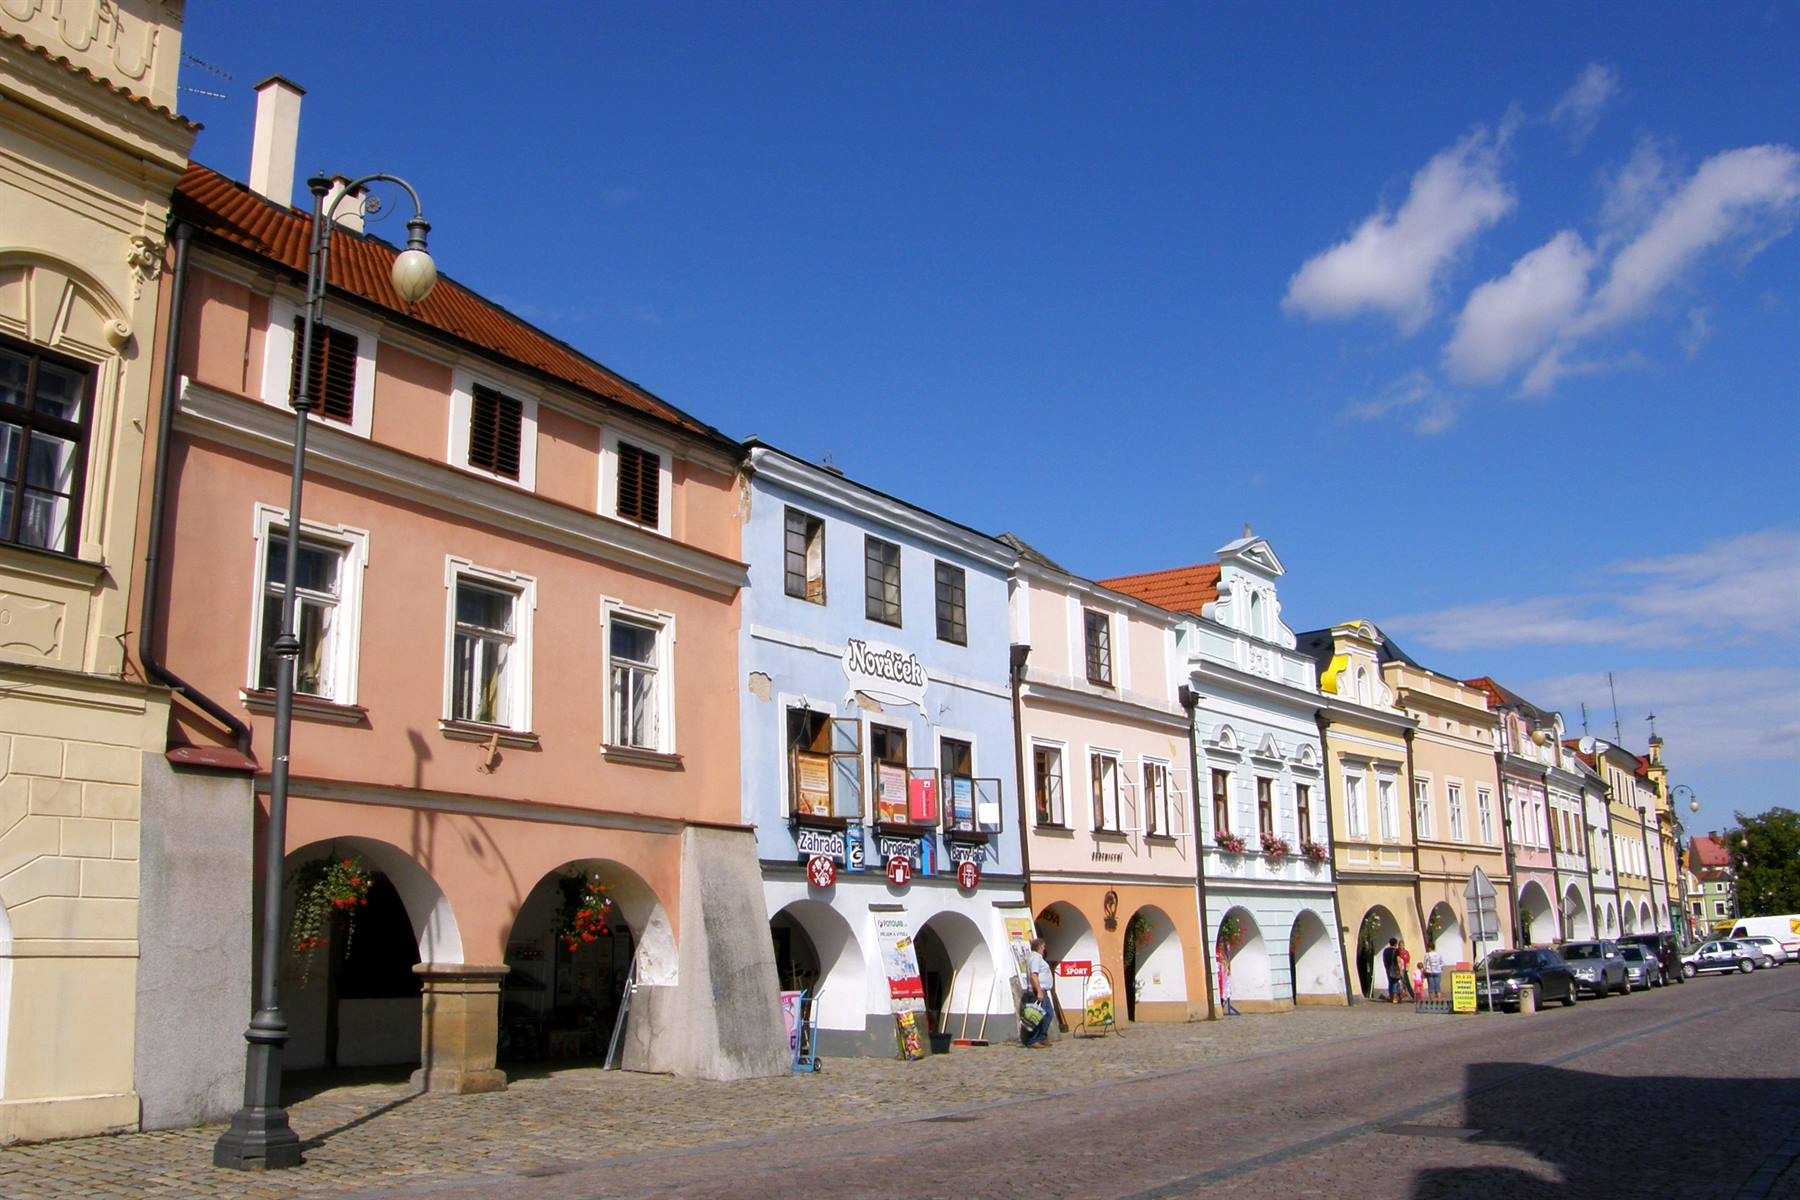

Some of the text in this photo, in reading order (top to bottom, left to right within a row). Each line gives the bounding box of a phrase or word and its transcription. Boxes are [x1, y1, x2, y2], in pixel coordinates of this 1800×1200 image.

[848, 638, 922, 687] Nováček
[799, 831, 843, 855] Zahrada
[881, 839, 918, 858] Drogerie
[1065, 967, 1089, 975] SPORT
